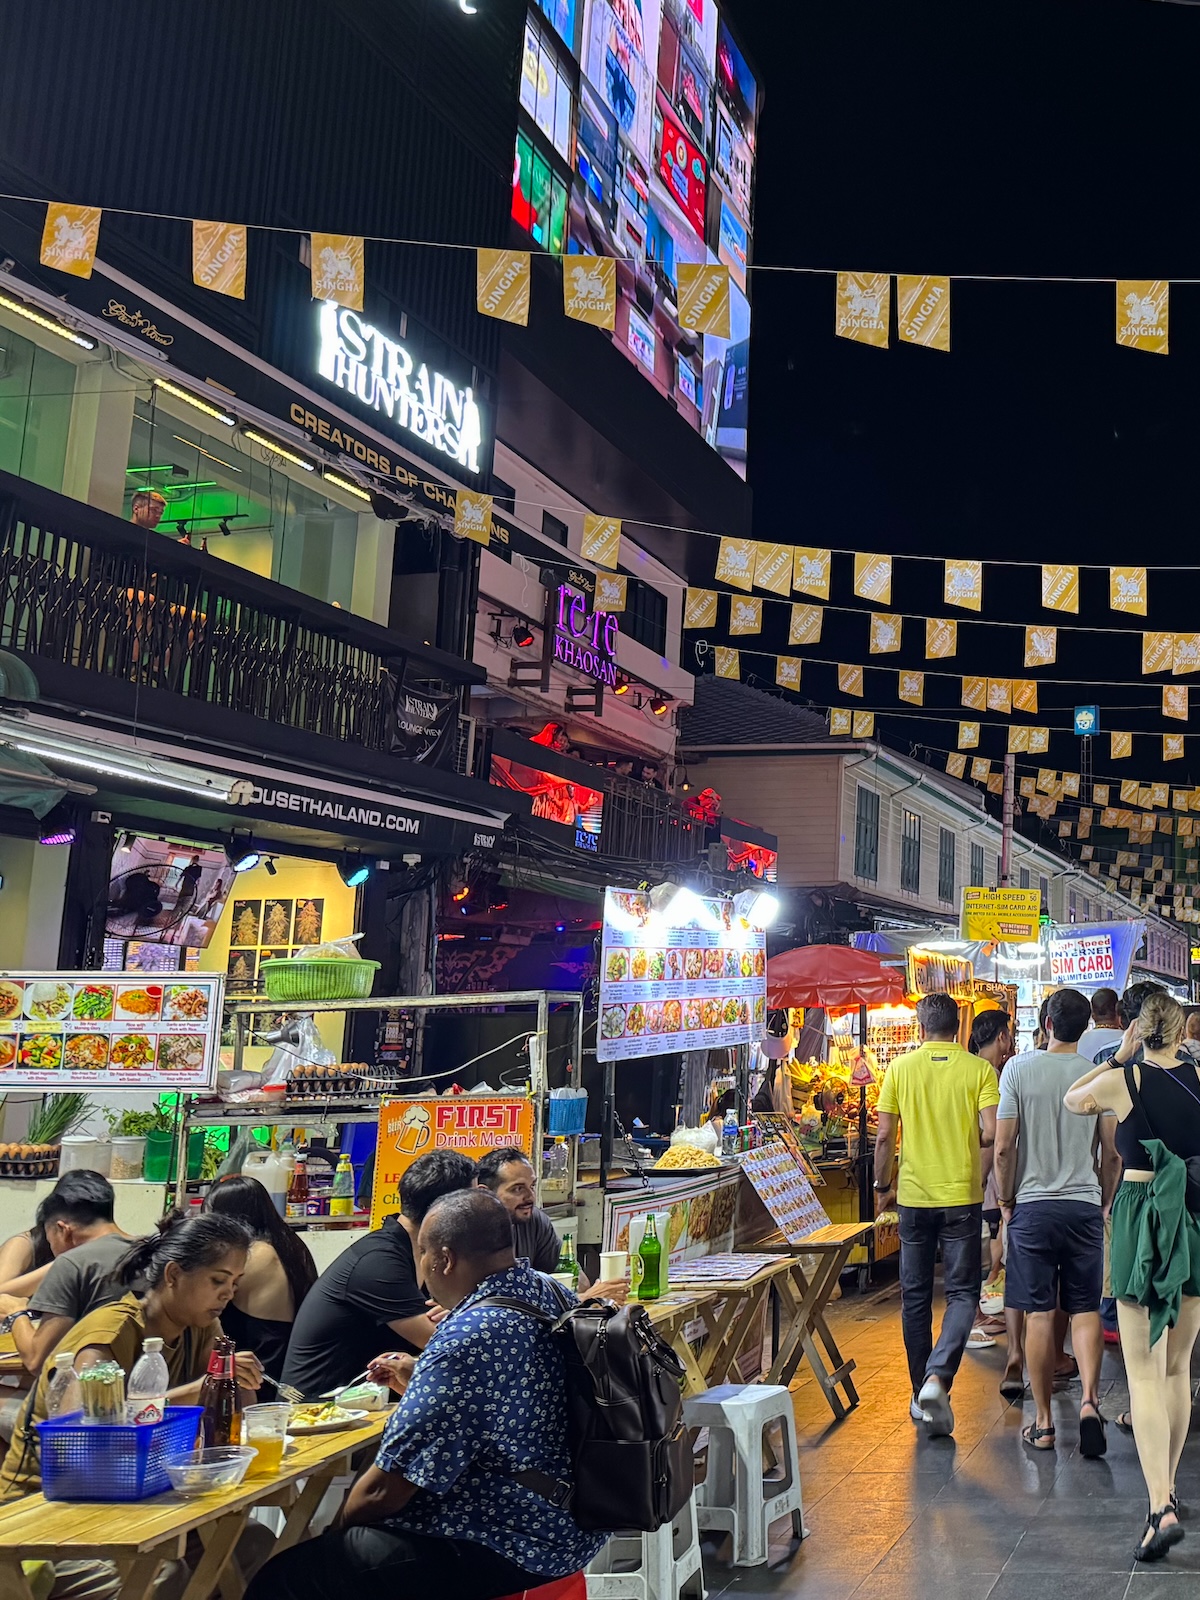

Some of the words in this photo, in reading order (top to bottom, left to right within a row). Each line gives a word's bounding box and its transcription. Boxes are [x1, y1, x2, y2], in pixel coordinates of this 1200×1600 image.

[45, 246, 90, 261] SINGHA
[201, 232, 241, 285] SINGHA
[316, 279, 360, 292] SINGHA
[483, 260, 524, 313] SINGHA
[568, 299, 612, 312] SINGHA
[685, 274, 723, 327] SINGHA
[906, 285, 944, 339] SINGHA
[840, 318, 885, 330] SINGHA
[1120, 326, 1164, 336] SINGHA
[337, 309, 466, 421] STRAIN
[332, 349, 466, 461] HUNTERS
[290, 403, 390, 474] CREATORS
[395, 465, 419, 487] OF
[457, 520, 487, 532] SINGHA
[587, 524, 616, 557] SINGHA
[719, 568, 750, 578] SINGHA
[759, 552, 789, 586] SINGHA
[859, 561, 889, 595] SINGHA
[796, 578, 826, 587] SINGHA
[1047, 572, 1074, 606] SINGHA
[689, 595, 714, 623] SINGHA
[733, 620, 758, 628] SINGHA
[794, 611, 820, 639] SINGHA
[930, 625, 954, 654] SINGHA
[1146, 637, 1170, 668] SINGHA
[555, 634, 617, 685] KHAOSAN
[718, 650, 736, 675] SINGHA
[842, 669, 860, 690] SINGHA
[964, 681, 984, 706] SINGHA
[1016, 684, 1034, 708] SINGHA
[398, 720, 422, 734] LOUNGE
[250, 786, 419, 835] OUSETHAILAND.COM
[1051, 947, 1111, 958] INTERNET
[1052, 958, 1074, 974] SIM
[1079, 955, 1113, 972] CARD
[436, 1105, 524, 1133] FIRST
[435, 1133, 476, 1147] Drink
[480, 1132, 523, 1147] Menu
[385, 1174, 399, 1183] LE
